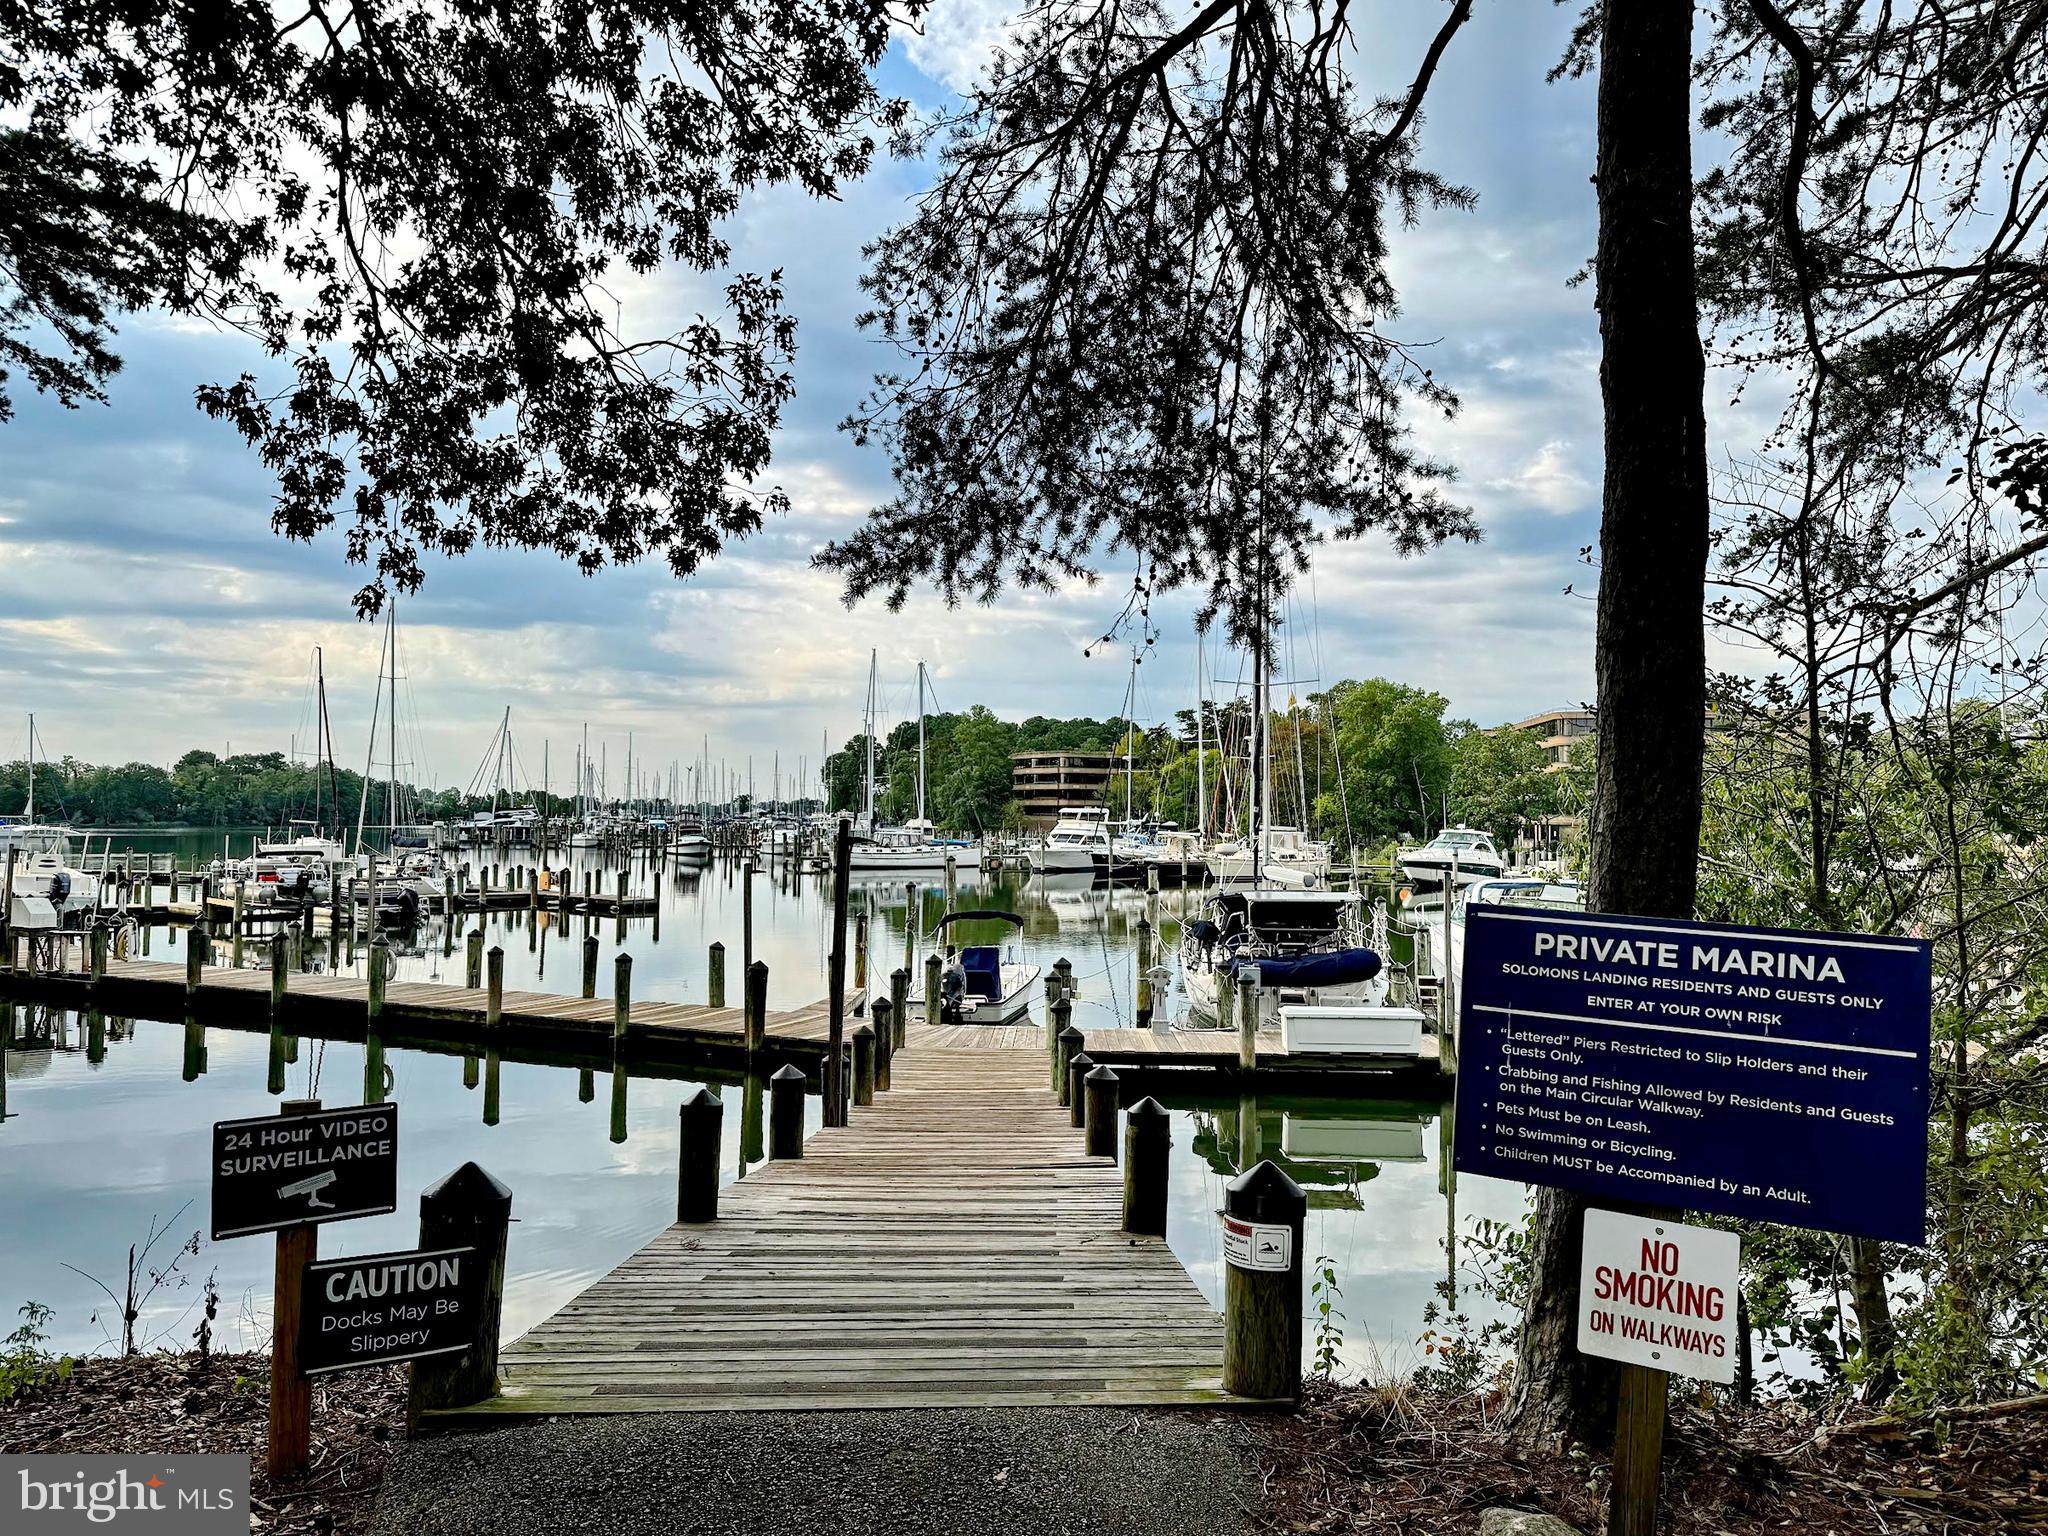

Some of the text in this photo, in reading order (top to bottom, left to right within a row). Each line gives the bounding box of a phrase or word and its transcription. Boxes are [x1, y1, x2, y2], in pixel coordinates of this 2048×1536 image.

[1534, 933, 1845, 983] PRIVATE MARINA
[1502, 964, 1883, 1009] SOLOMONS LANDING RESIDENTS AND GUESTS ONLY
[1587, 996, 1781, 1025] ENTER AT YOUR OWN RISK
[1501, 1044, 1583, 1064] Guests Only.
[1573, 1037, 1606, 1050] Piers
[1610, 1041, 1681, 1059] Restricted
[1685, 1050, 1700, 1061] to
[1705, 1052, 1731, 1066] Slip
[1736, 1056, 1793, 1072] Holders
[1797, 1065, 1826, 1076] and
[1831, 1066, 1868, 1080] their
[1498, 1065, 1894, 1125] Crabbing and Fishing Allowed by Residents and Guests
[1499, 1083, 1703, 1118] on the Main Circular Walkway.
[224, 1116, 388, 1151] 24 Hour VIDEO
[1496, 1102, 1650, 1133] Pets Must be on Leash.
[220, 1140, 391, 1176] SURVEILLANCE
[1495, 1124, 1676, 1161] No Swimming or Bicycling.
[1494, 1146, 1810, 1203] Children MUST be Accompanied by an Adult.
[1640, 1238, 1679, 1276] NO
[326, 1258, 460, 1303] CAUTION
[1594, 1265, 1724, 1321] SMOKING
[322, 1299, 460, 1332] Docks May Be
[1590, 1309, 1726, 1358] ON WALKWAYS
[350, 1328, 431, 1352] Slippery
